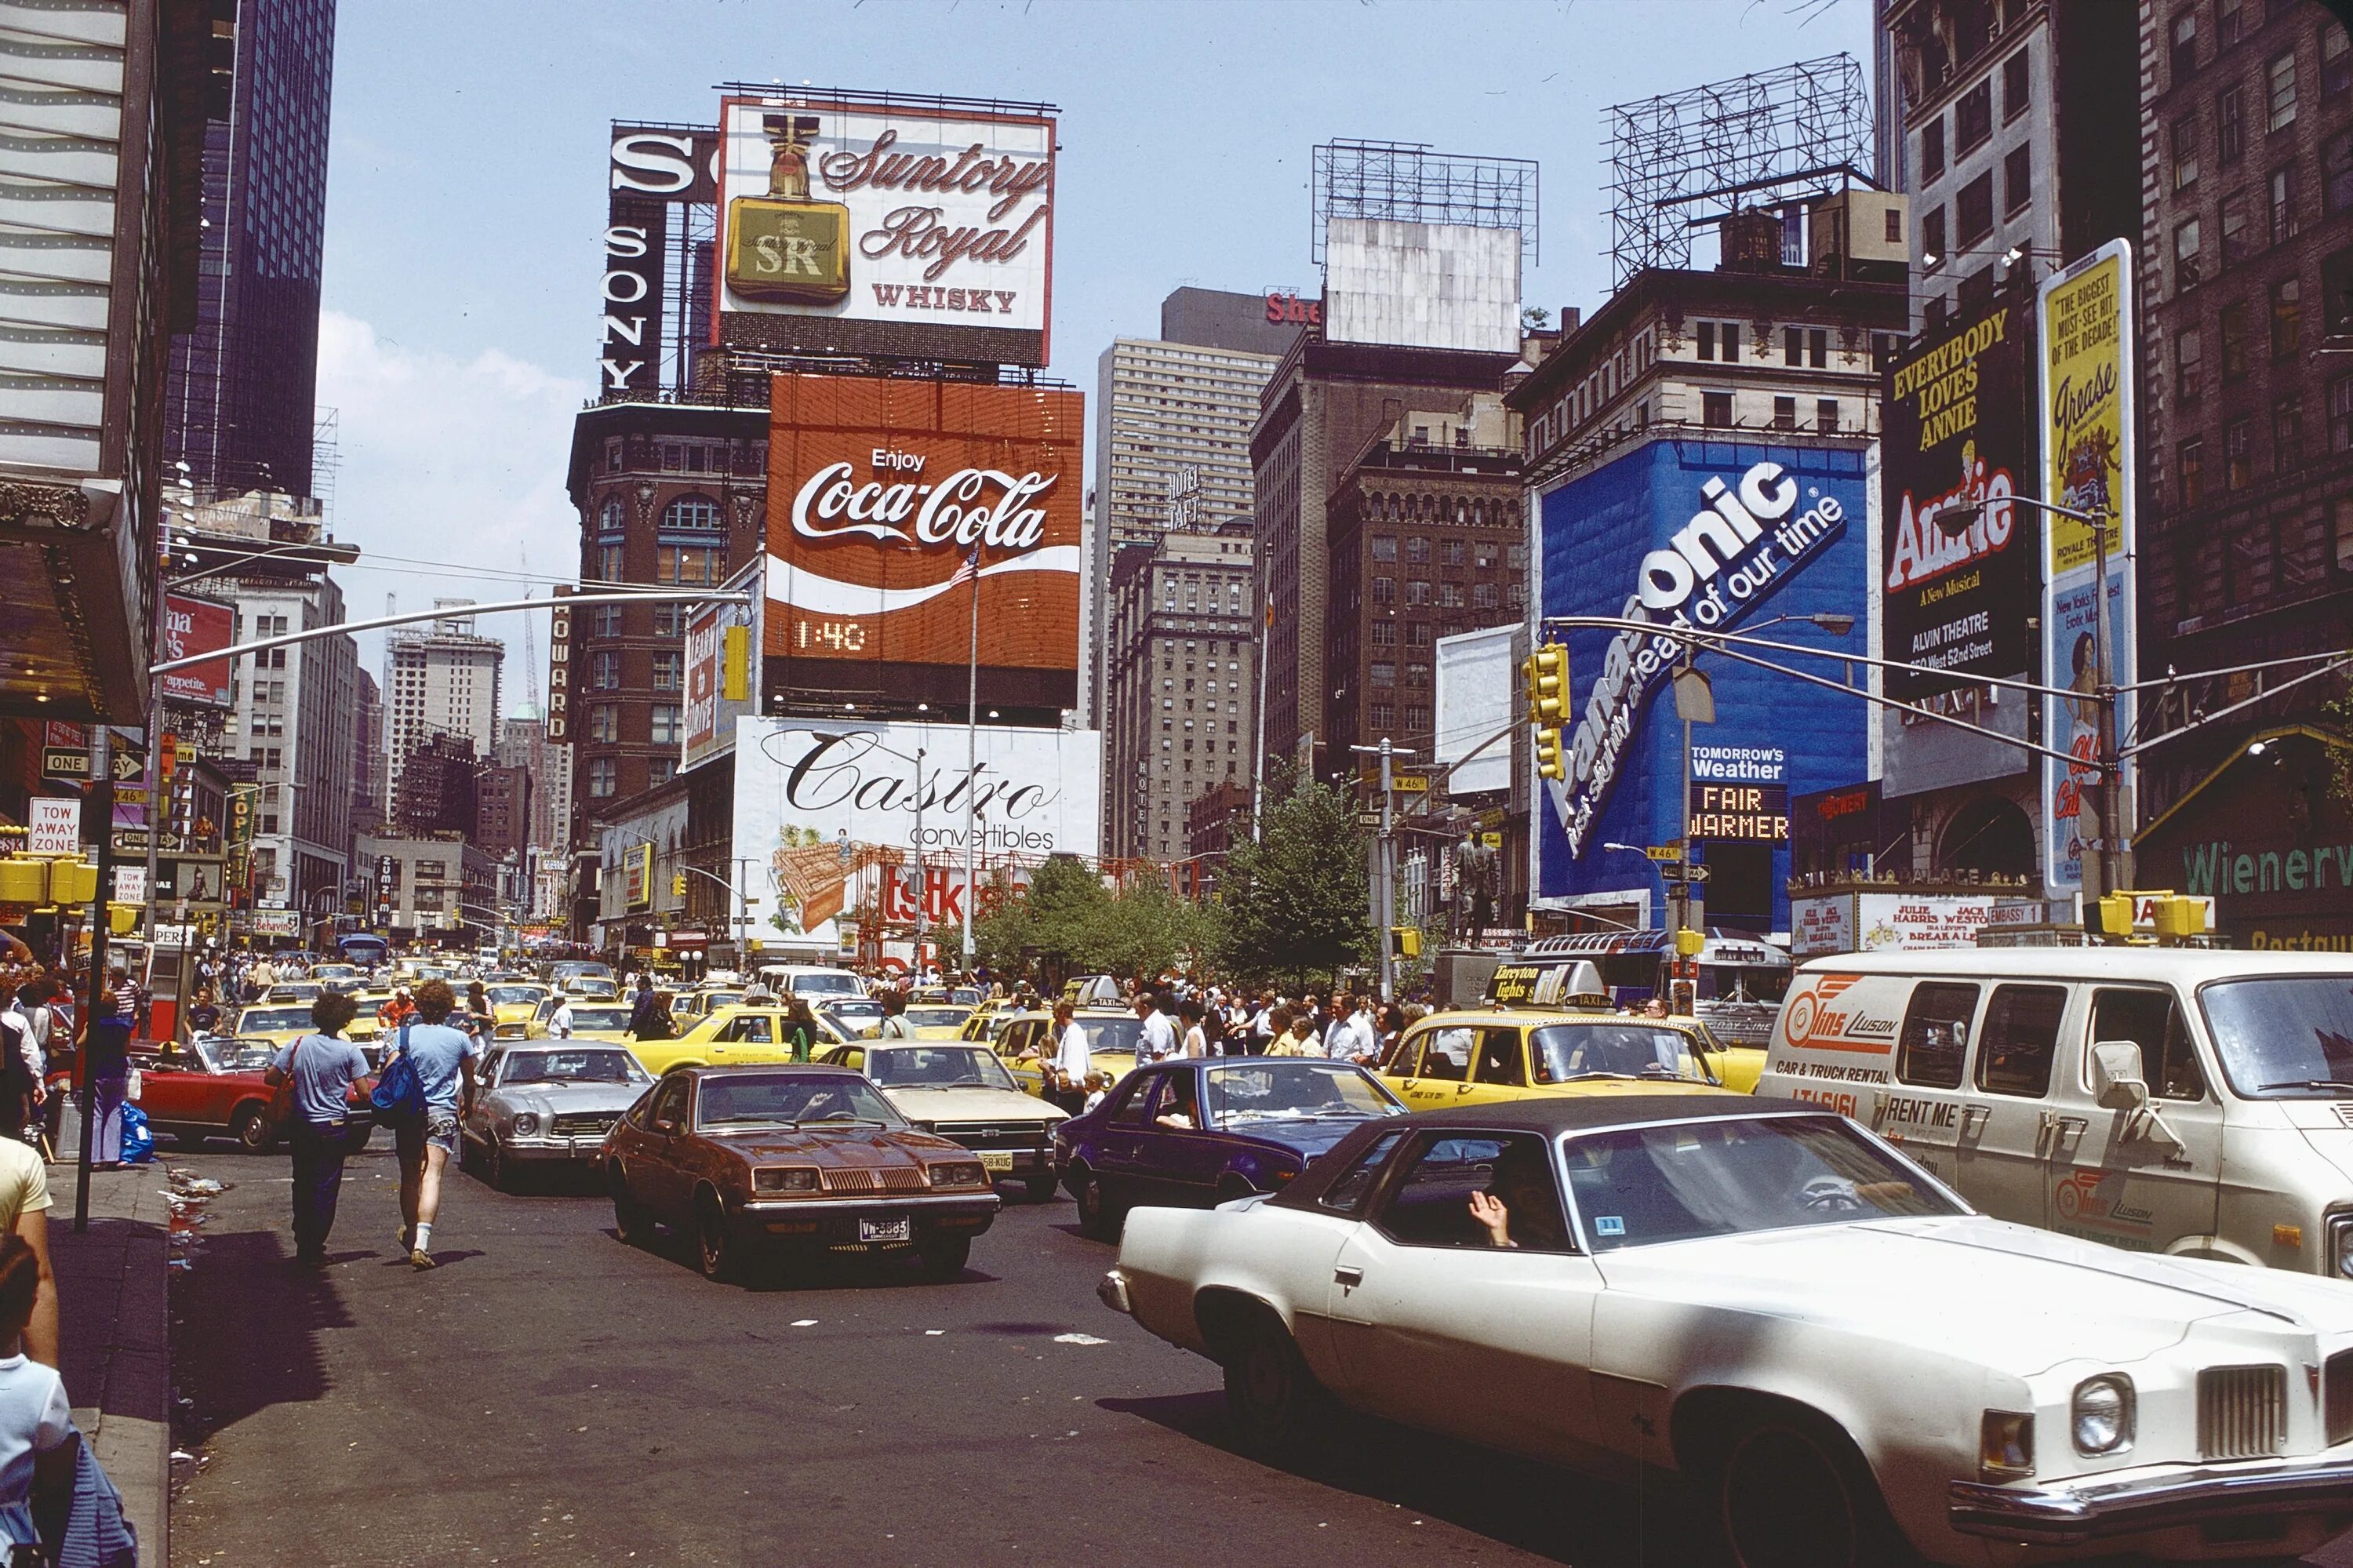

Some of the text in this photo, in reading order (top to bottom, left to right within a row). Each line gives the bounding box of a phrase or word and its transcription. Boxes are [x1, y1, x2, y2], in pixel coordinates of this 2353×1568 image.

[820, 129, 1053, 223] Suntory
[756, 235, 823, 275] SR
[860, 204, 1049, 282] Royal
[872, 283, 1016, 313] WHISKY
[2078, 272, 2110, 307] BIGGEST
[599, 226, 648, 390] SONY
[2100, 293, 2113, 318] HIT
[1893, 307, 2008, 401] EVERYBODY
[2052, 344, 2062, 366] OF
[2064, 336, 2078, 360] THE
[1919, 362, 1978, 419] LOVES
[1919, 395, 1977, 451] ANNIE
[872, 447, 926, 472] Enjoy
[1168, 465, 1200, 501] HOTEL
[791, 461, 1058, 548] Coca-Cola
[1168, 496, 1200, 530] TAFT
[2057, 540, 2084, 558] ROYALE
[2086, 527, 2118, 548] THTRE
[1920, 569, 1980, 607] A New Musical
[2056, 600, 2071, 614] New
[1912, 611, 1988, 653] ALVIN THEATRE
[1589, 704, 1630, 802] slightly
[1695, 584, 1728, 624] of
[1728, 547, 1777, 598] our
[1774, 497, 1842, 555] time
[1928, 653, 1947, 669] West
[1947, 646, 1969, 666] 52nd
[1969, 639, 1992, 659] Street
[52, 758, 130, 773] ONE AY
[1691, 747, 1784, 762] TOMORROW'S
[760, 729, 1060, 819] Castro
[1693, 759, 1782, 780] Weather
[1396, 780, 1403, 788] W
[1406, 779, 1417, 788] 46
[122, 791, 136, 802] 46
[1704, 787, 1762, 810] FAIR
[43, 807, 71, 819] TOW
[35, 824, 76, 835] AWAY
[910, 824, 1054, 849] convertibles
[35, 839, 75, 850] ZONE
[1659, 849, 1671, 858] 46
[1893, 915, 1938, 923] HARRIS
[1957, 907, 1984, 915] JACK
[1991, 906, 2036, 923] EMBASSY 1
[1494, 965, 1540, 980] Tareyton
[1099, 998, 1115, 1006] TAXI
[1497, 980, 1525, 1001] lights
[1580, 995, 1600, 1006] TAXI
[1776, 1060, 1889, 1085] CAR & TRUCK RENTAL
[1886, 1097, 1958, 1128] RENT ME
